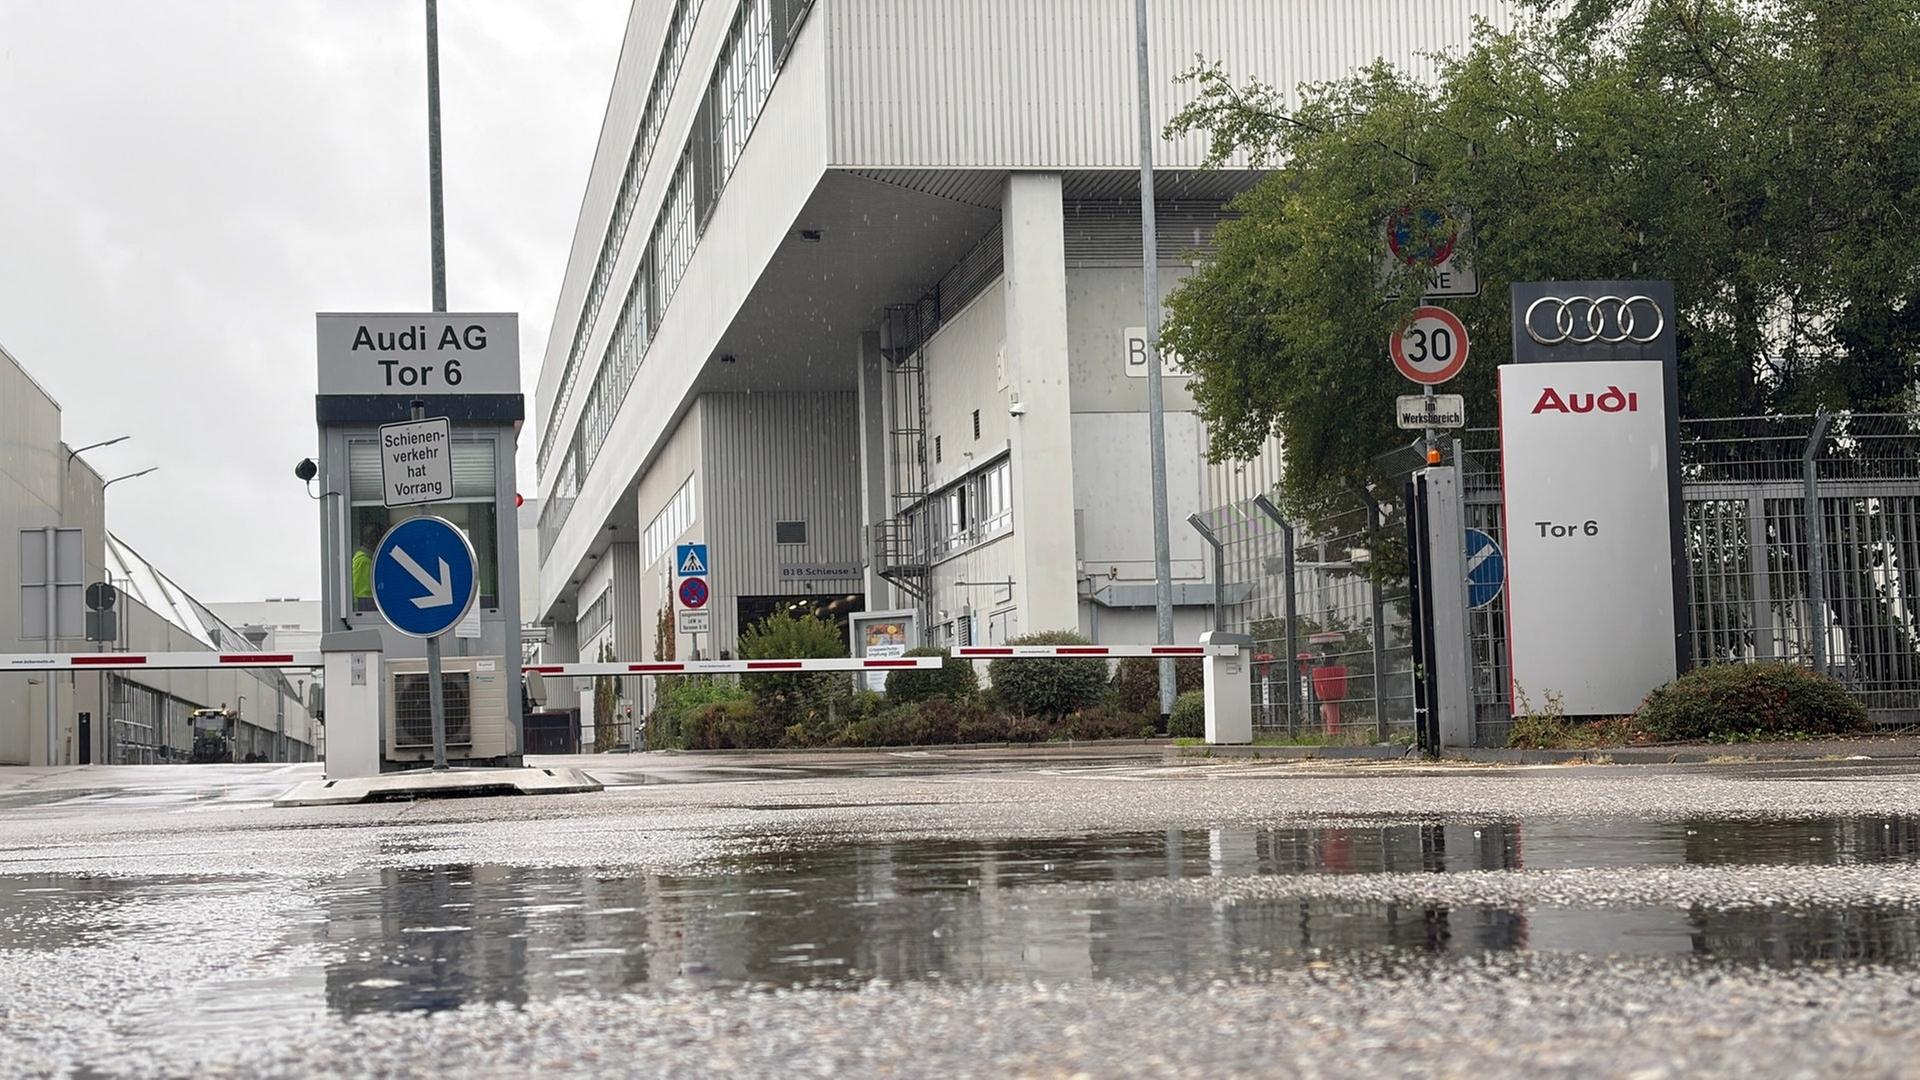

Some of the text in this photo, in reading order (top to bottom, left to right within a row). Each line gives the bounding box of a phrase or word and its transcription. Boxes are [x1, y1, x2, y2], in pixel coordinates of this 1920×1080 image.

[351, 325, 487, 351] Audi AG
[1408, 328, 1451, 362] 30
[378, 359, 462, 386] Tor 6
[1531, 386, 1638, 414] Audi
[1402, 412, 1460, 424] Werksbereich
[385, 431, 445, 447] Schienen-
[393, 446, 438, 463] verkehr
[407, 464, 426, 478] hat
[394, 481, 442, 496] Vorrang
[1534, 520, 1598, 537] Tor 6
[805, 567, 849, 576] Schleuse
